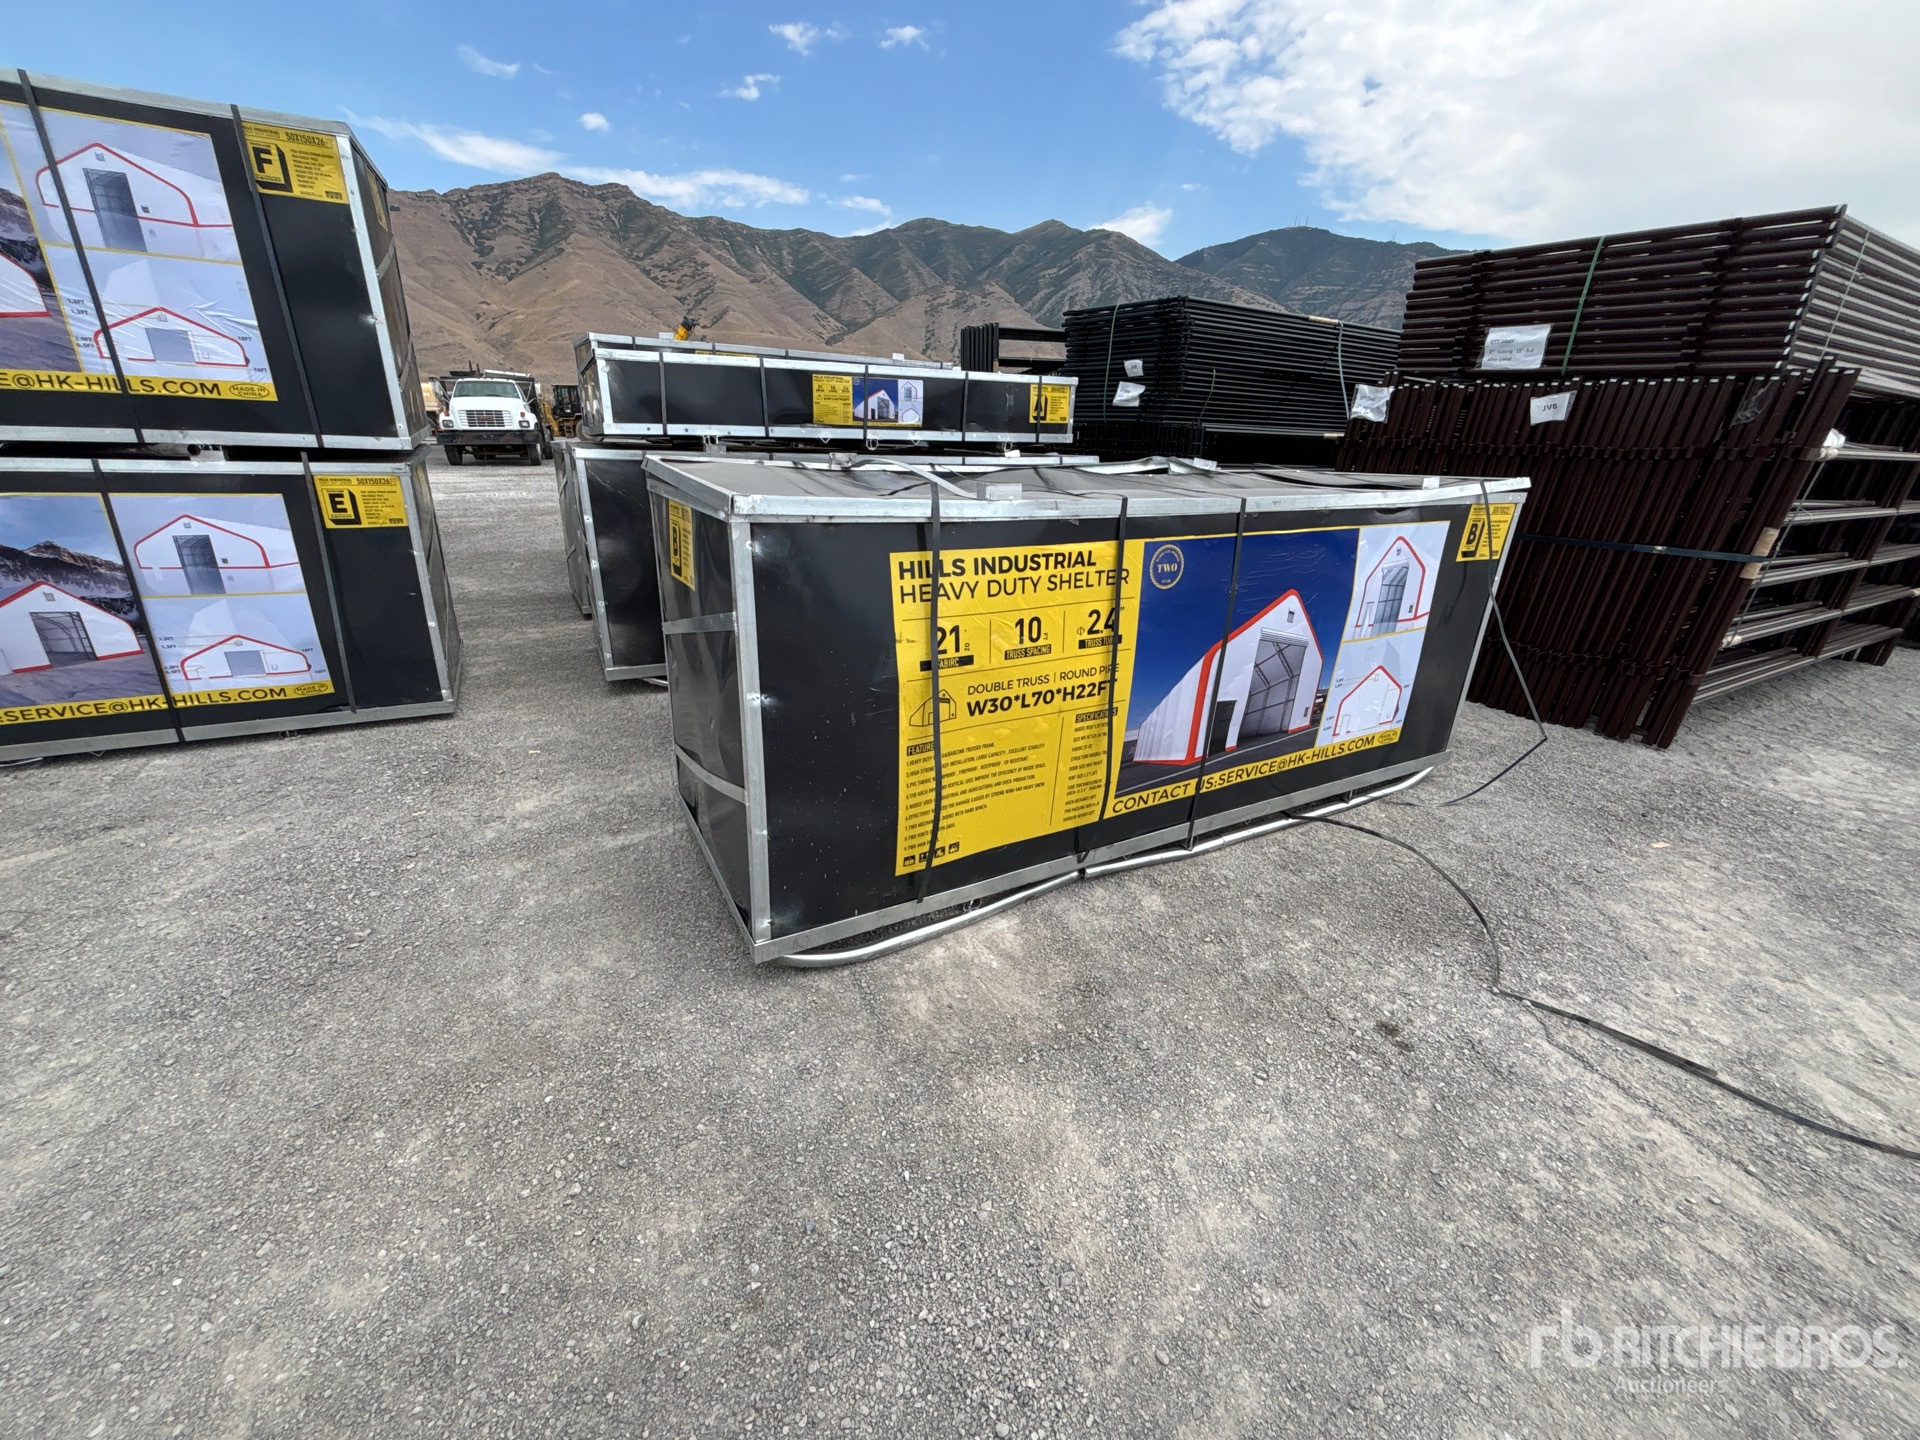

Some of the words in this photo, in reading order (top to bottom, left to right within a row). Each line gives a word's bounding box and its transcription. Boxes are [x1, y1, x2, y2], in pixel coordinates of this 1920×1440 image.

[252, 146, 273, 174] F
[1542, 403, 1558, 412] JV8
[328, 493, 348, 513] E
[672, 526, 678, 556] B
[1466, 523, 1478, 545] B
[898, 558, 966, 580] HILLS
[974, 550, 1096, 576] INDUSTRIAL
[1157, 562, 1178, 573] TWO
[900, 580, 979, 604] HEAVY
[987, 575, 1042, 598] DUTY
[1047, 568, 1130, 591] SHELTER
[937, 625, 960, 654] 21
[1015, 616, 1041, 644] 10
[1007, 648, 1026, 660] TRUSS
[1026, 645, 1050, 658] SPACING
[1085, 638, 1102, 648] TRUSS
[1103, 636, 1114, 646] TUB
[938, 658, 960, 669] ABIRC
[968, 679, 1014, 696] DOUBLE
[1017, 674, 1050, 688] TRUSS
[1060, 667, 1097, 682] ROUND
[1076, 708, 1116, 723] SPECIFICATIS
[908, 742, 934, 755] FEATURE
[1112, 782, 1191, 813] CONTACT
